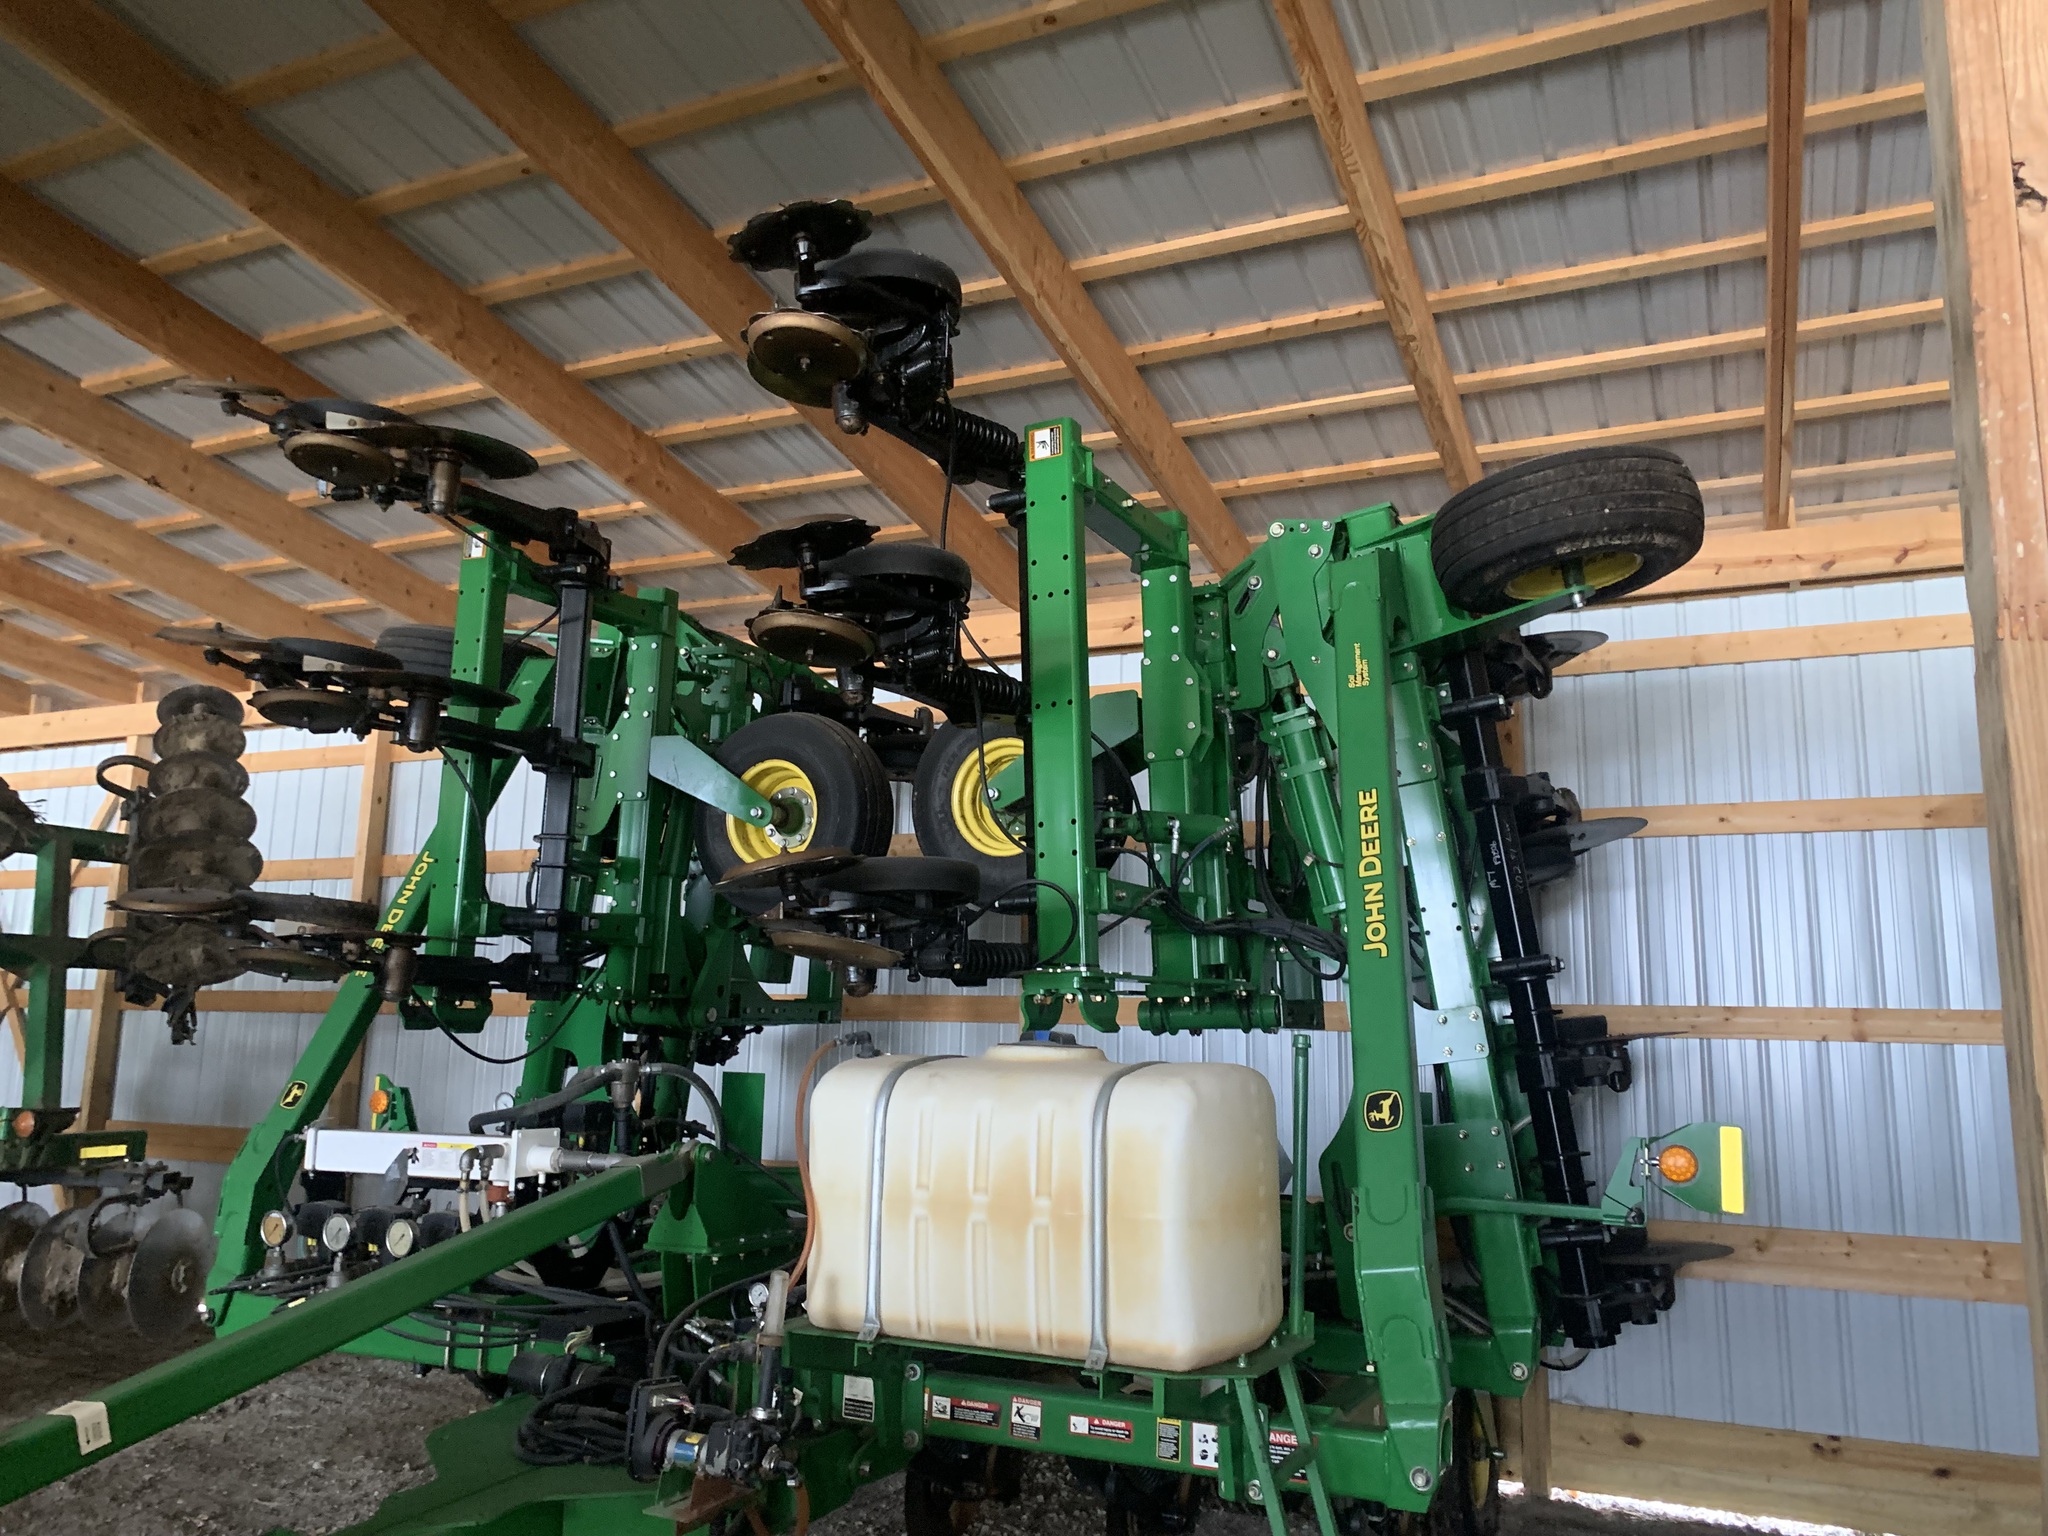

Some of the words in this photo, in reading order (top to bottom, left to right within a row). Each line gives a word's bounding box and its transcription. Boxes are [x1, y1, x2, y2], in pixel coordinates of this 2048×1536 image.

[1353, 642, 1363, 687] Management
[1361, 659, 1370, 687] System
[1347, 674, 1356, 689] Soil
[1357, 787, 1383, 879] DEERE
[397, 851, 434, 904] JOHN
[1362, 880, 1387, 958] JOHN
[966, 1400, 989, 1409] DANGER
[1018, 1396, 1042, 1408] DANGER
[1101, 1419, 1126, 1428] DANGER
[1269, 1432, 1298, 1446] ANGE
